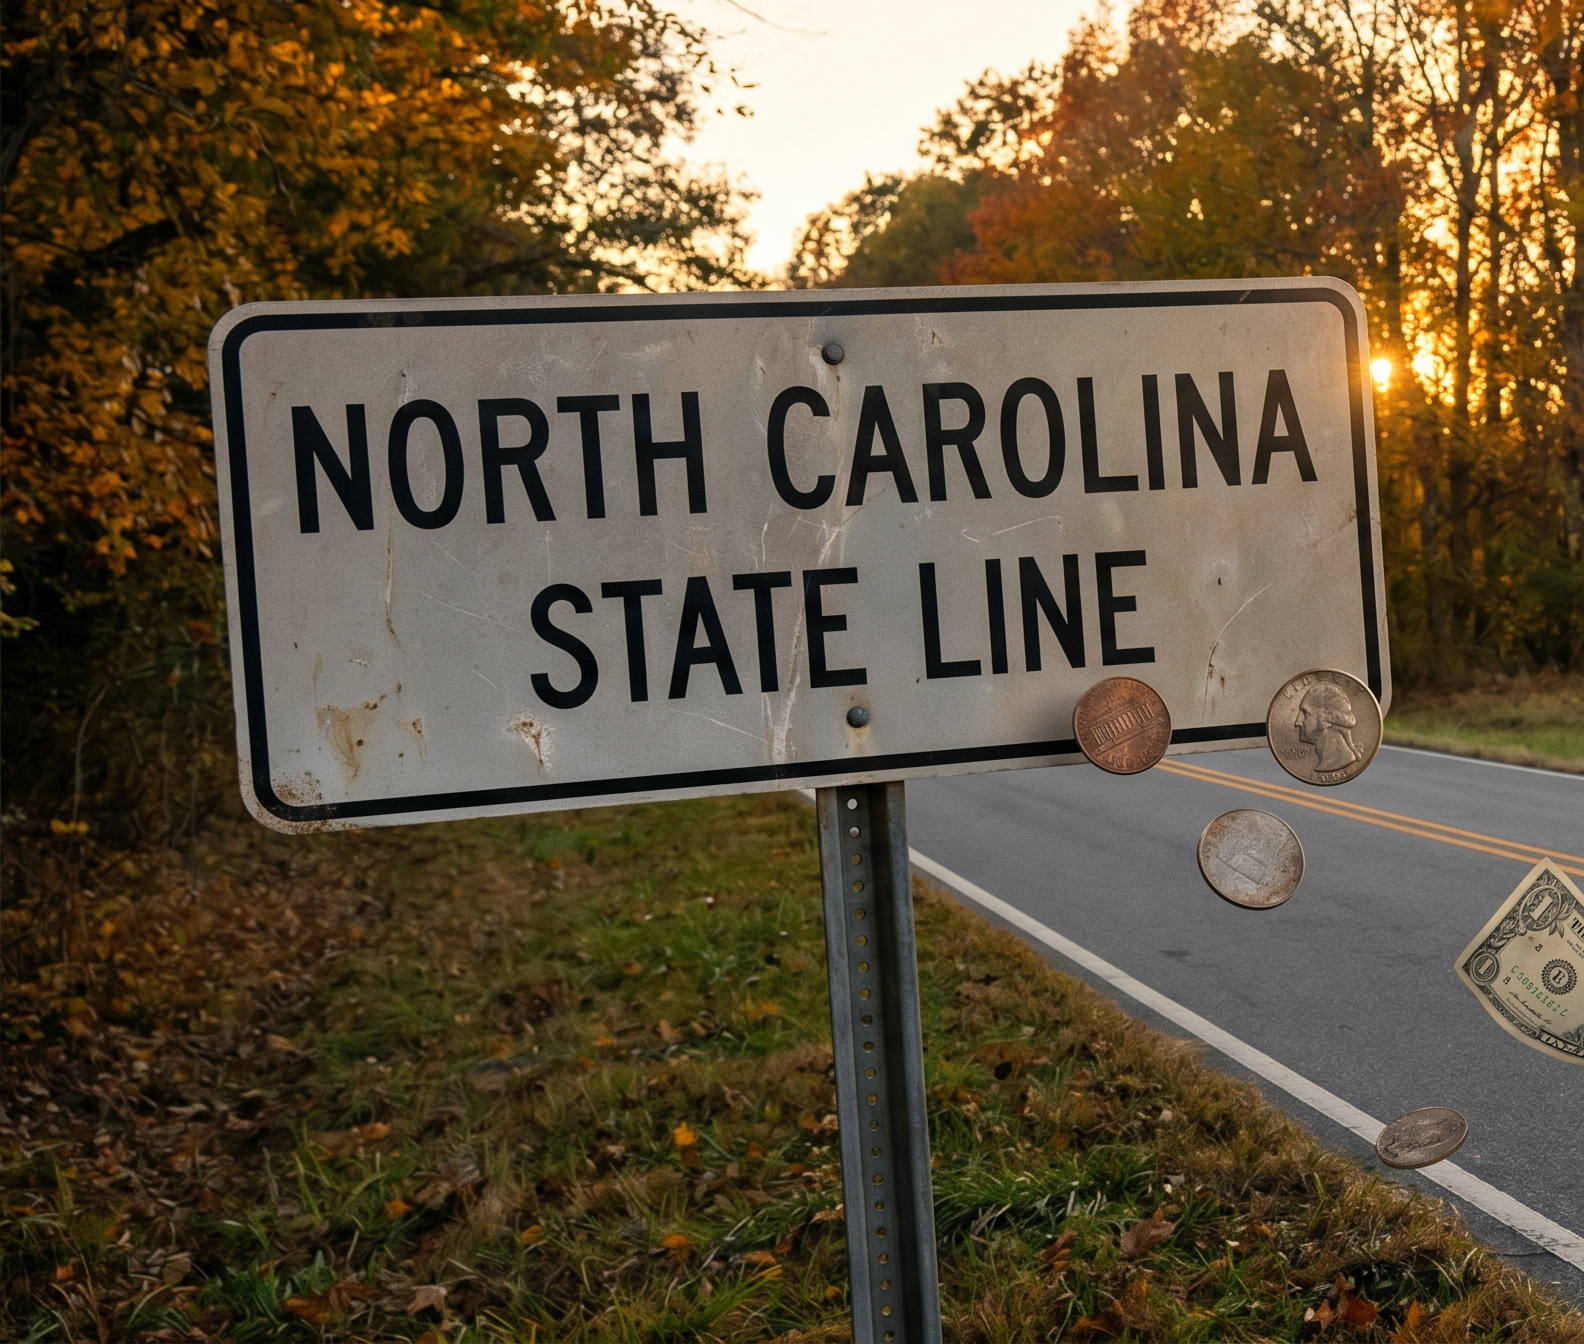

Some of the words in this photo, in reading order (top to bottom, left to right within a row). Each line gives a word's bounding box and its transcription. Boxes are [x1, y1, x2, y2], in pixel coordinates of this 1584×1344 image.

[291, 392, 708, 534] NORTH
[767, 368, 1319, 511] CAROLINA
[531, 567, 868, 710] STATE
[919, 550, 1156, 680] LINE
